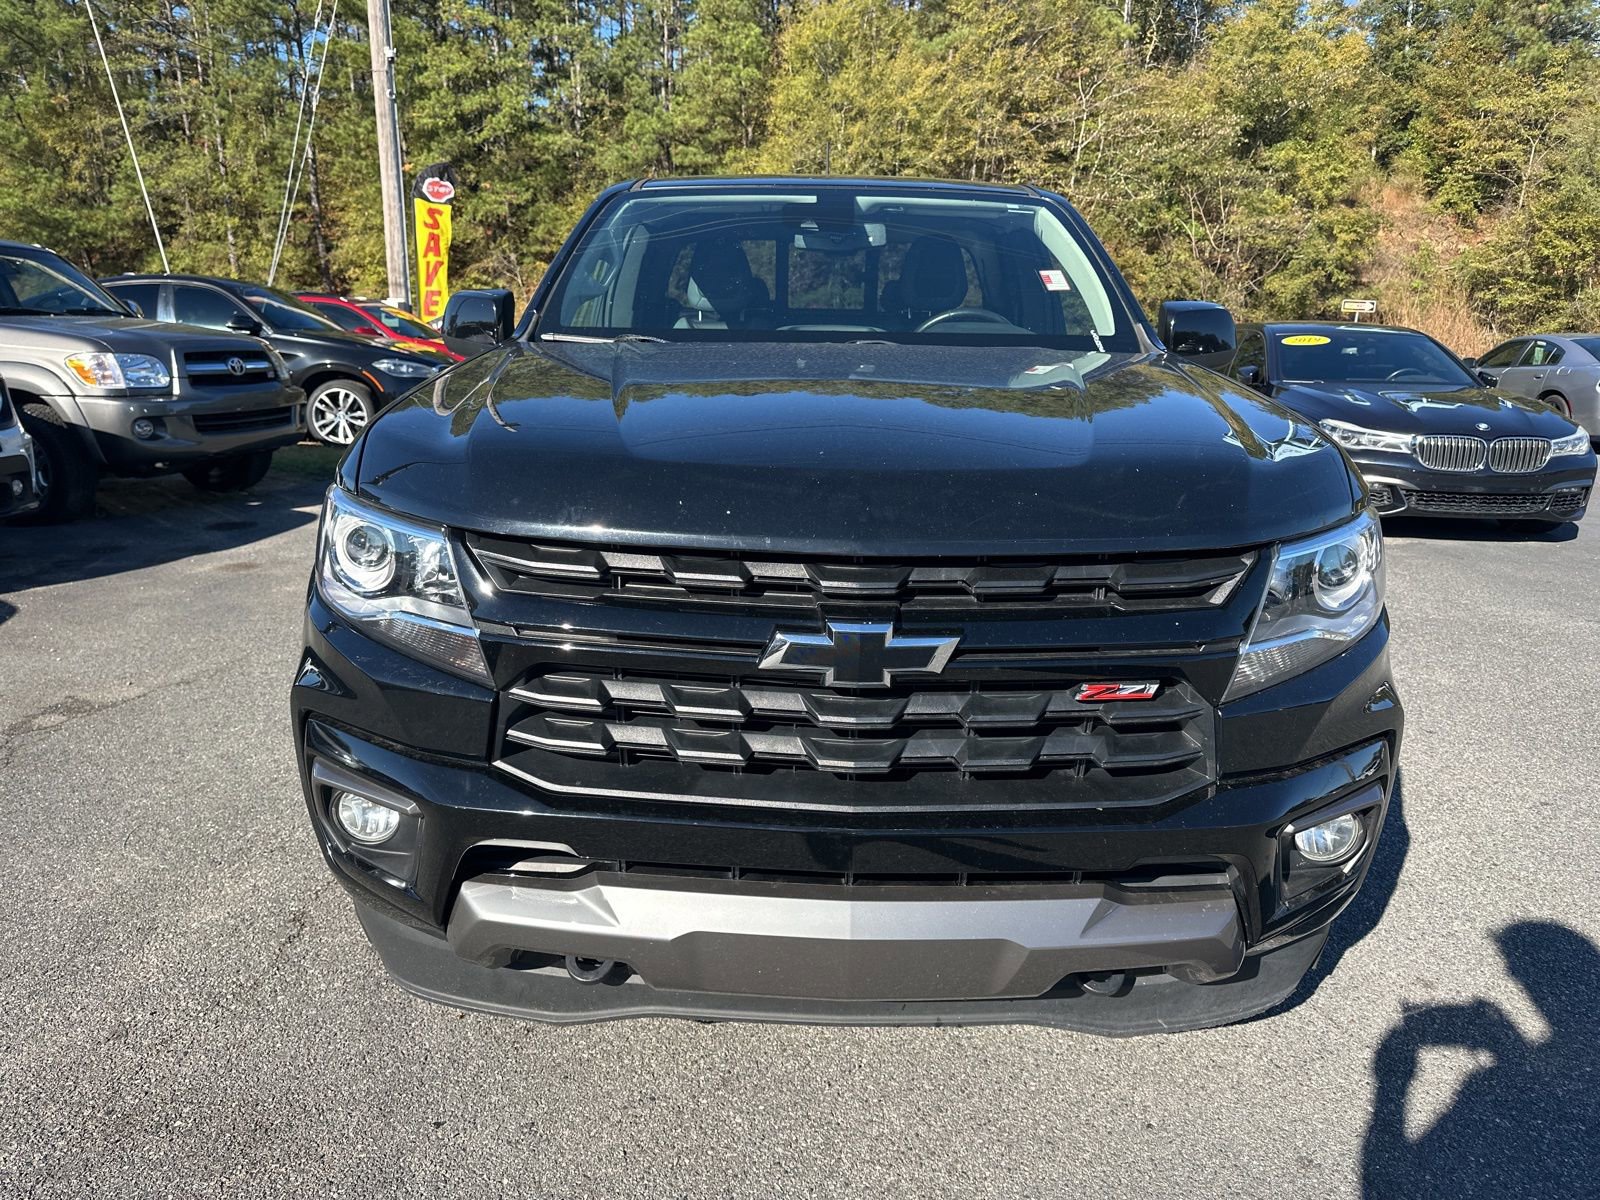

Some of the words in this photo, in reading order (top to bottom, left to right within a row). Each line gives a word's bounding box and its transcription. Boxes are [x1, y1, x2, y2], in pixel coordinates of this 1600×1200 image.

[427, 184, 451, 194] STOP
[423, 207, 444, 316] SAVE
[1075, 683, 1160, 701] Z71
